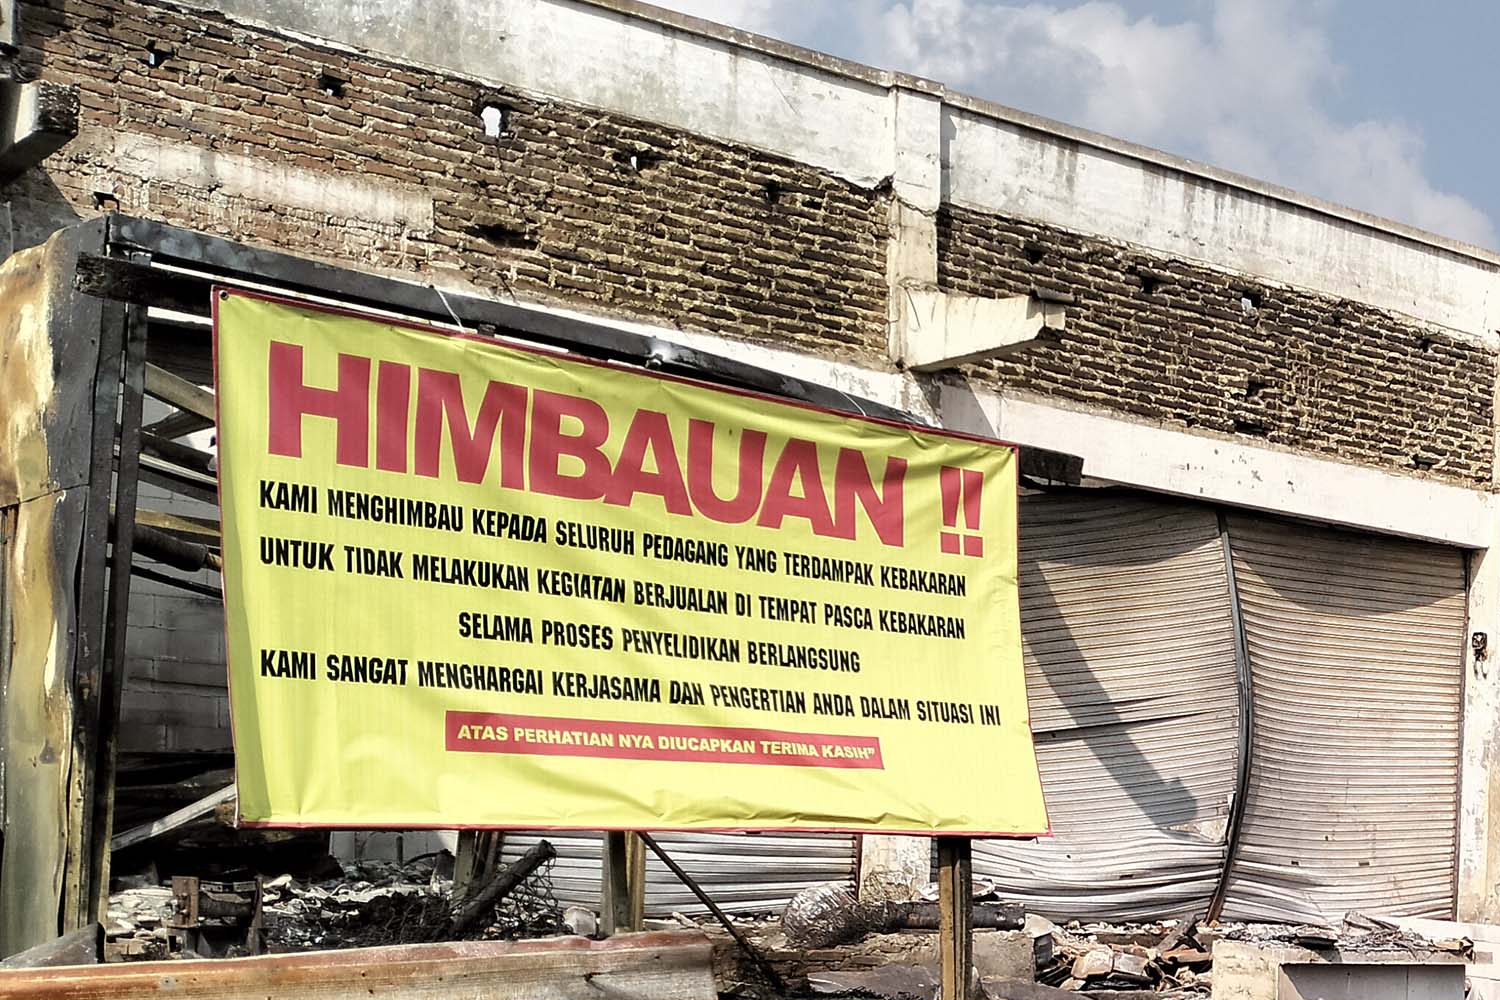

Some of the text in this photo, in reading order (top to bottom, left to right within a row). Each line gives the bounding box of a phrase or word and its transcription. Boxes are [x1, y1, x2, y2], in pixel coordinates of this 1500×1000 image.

[268, 340, 984, 558] HIMBAUAN !!
[260, 480, 966, 596] KAMI MENGHIMBAU KEPADA SELURUH PEDAGANG YANG TERDAMPAK KEBAKARAN
[260, 536, 965, 639] UNTUK TIDAK MELAKUKAN KEGIATAN BERJUALAN DI TEMPAT PASCA KEBAKARAN
[260, 649, 1001, 726] KAMI SANGAT MENGHARGAI KERJASAMA DAN PENGERTIAN ANDA DALAM SITUASI INI
[459, 612, 860, 673] SELAMA PROSES PENYELIDIKAN BERLANGSUNG
[457, 724, 508, 741] ATAS
[514, 727, 614, 747] PERHATIAN
[618, 733, 655, 749] NYA
[658, 735, 755, 754] DIUCAPKAN
[760, 740, 818, 758] TERIMA
